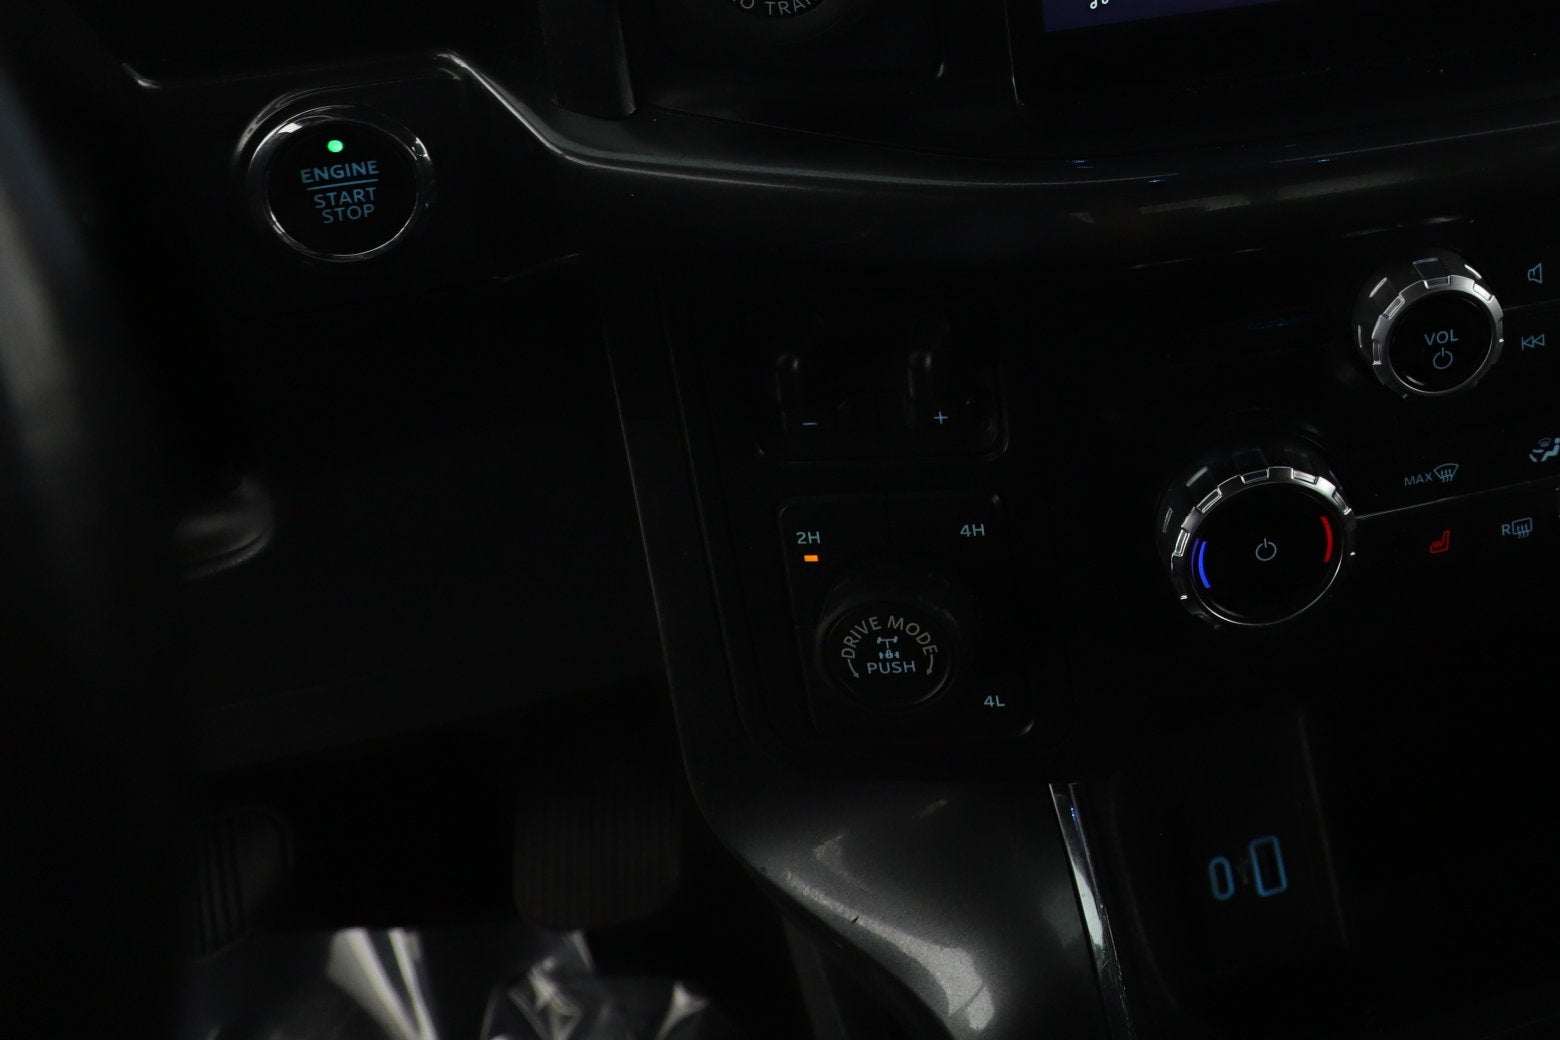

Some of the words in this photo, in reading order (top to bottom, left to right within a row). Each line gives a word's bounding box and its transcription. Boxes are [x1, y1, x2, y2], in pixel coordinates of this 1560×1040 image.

[300, 160, 380, 184] ENGINE
[313, 187, 377, 209] START
[322, 204, 375, 224] STOP
[1423, 328, 1459, 345] VOL
[1404, 471, 1433, 487] MAX
[796, 530, 821, 545] 2H
[959, 523, 986, 538] 4H
[841, 616, 882, 659] DRIVE
[887, 615, 939, 656] MODE
[866, 660, 916, 675] PUSH
[983, 695, 1006, 708] 4L
